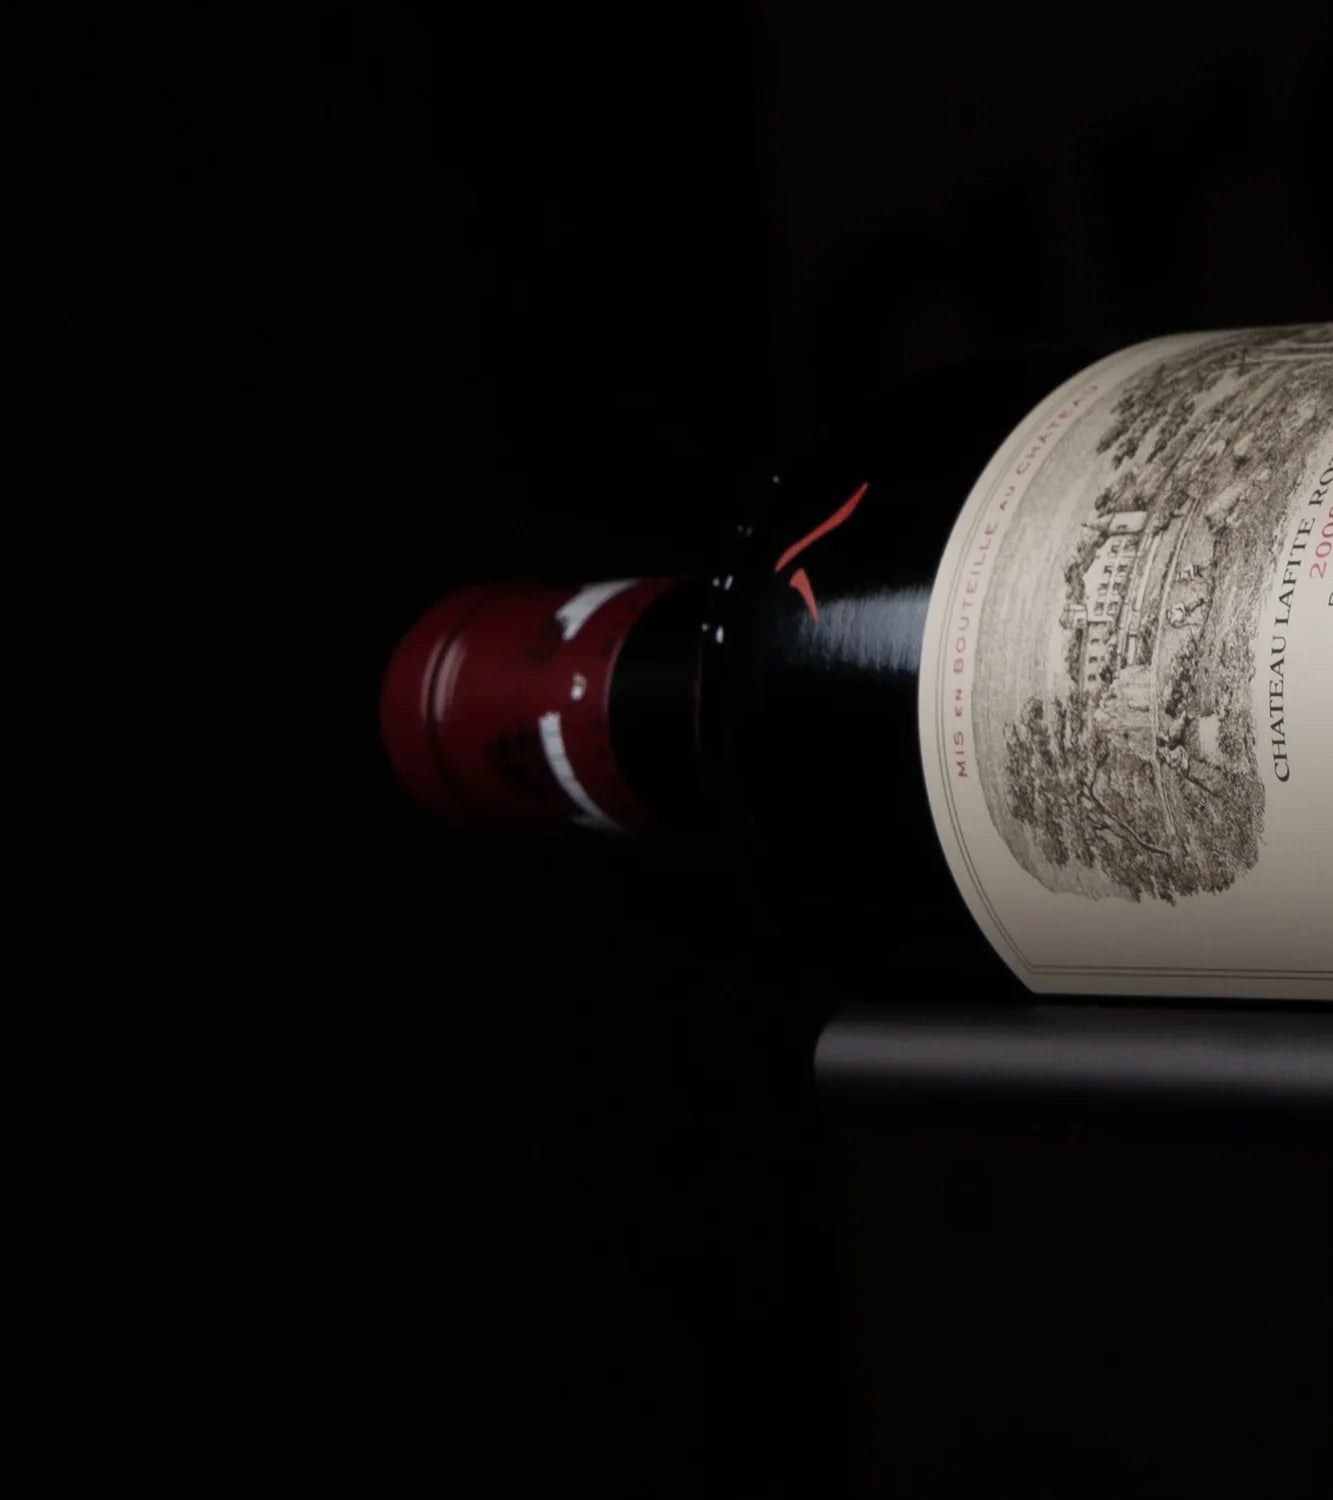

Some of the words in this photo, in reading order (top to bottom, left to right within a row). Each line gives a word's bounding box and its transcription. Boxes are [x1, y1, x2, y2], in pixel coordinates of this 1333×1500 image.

[952, 521, 999, 676] BOUTEILLE
[1274, 515, 1317, 628] LAFITE
[953, 729, 968, 779] MIS
[1269, 634, 1291, 783] CHATEAU
